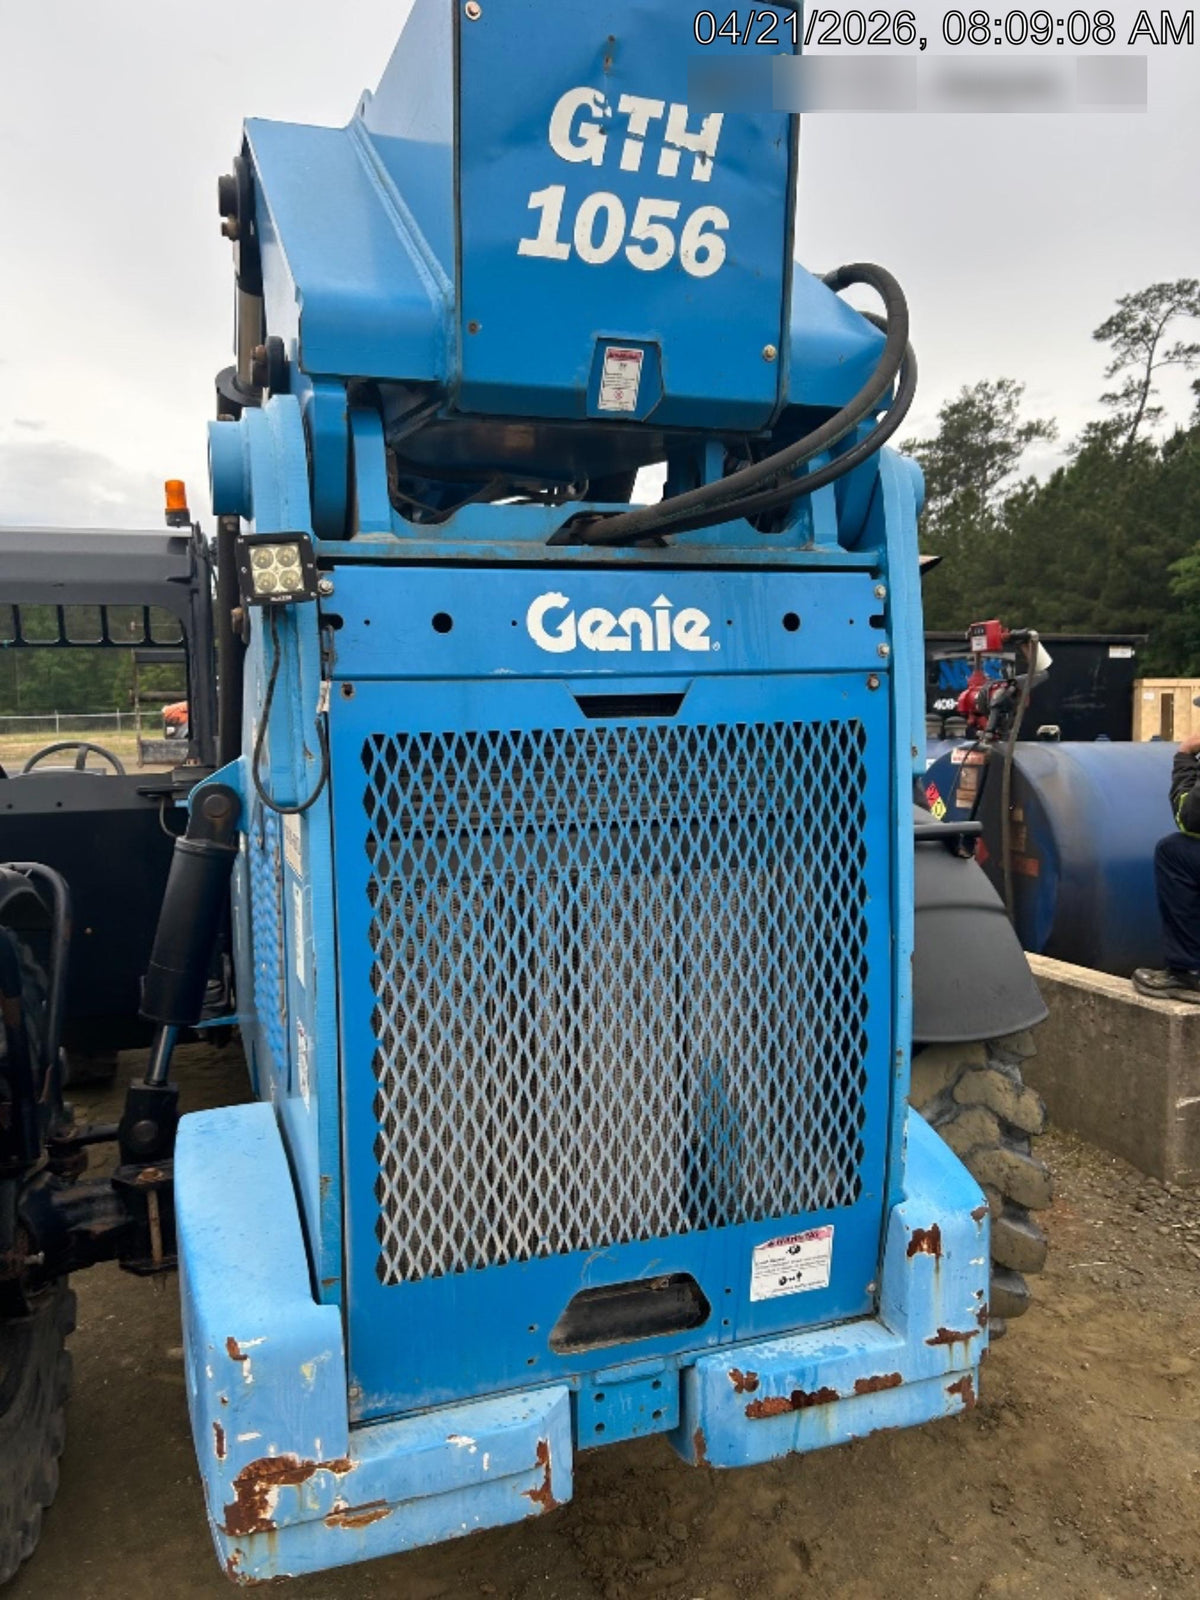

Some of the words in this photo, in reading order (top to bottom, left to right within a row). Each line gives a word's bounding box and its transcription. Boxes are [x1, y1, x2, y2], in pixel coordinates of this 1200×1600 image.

[549, 86, 724, 182] GTH
[517, 184, 730, 278] 1056
[526, 591, 711, 653] Genie
